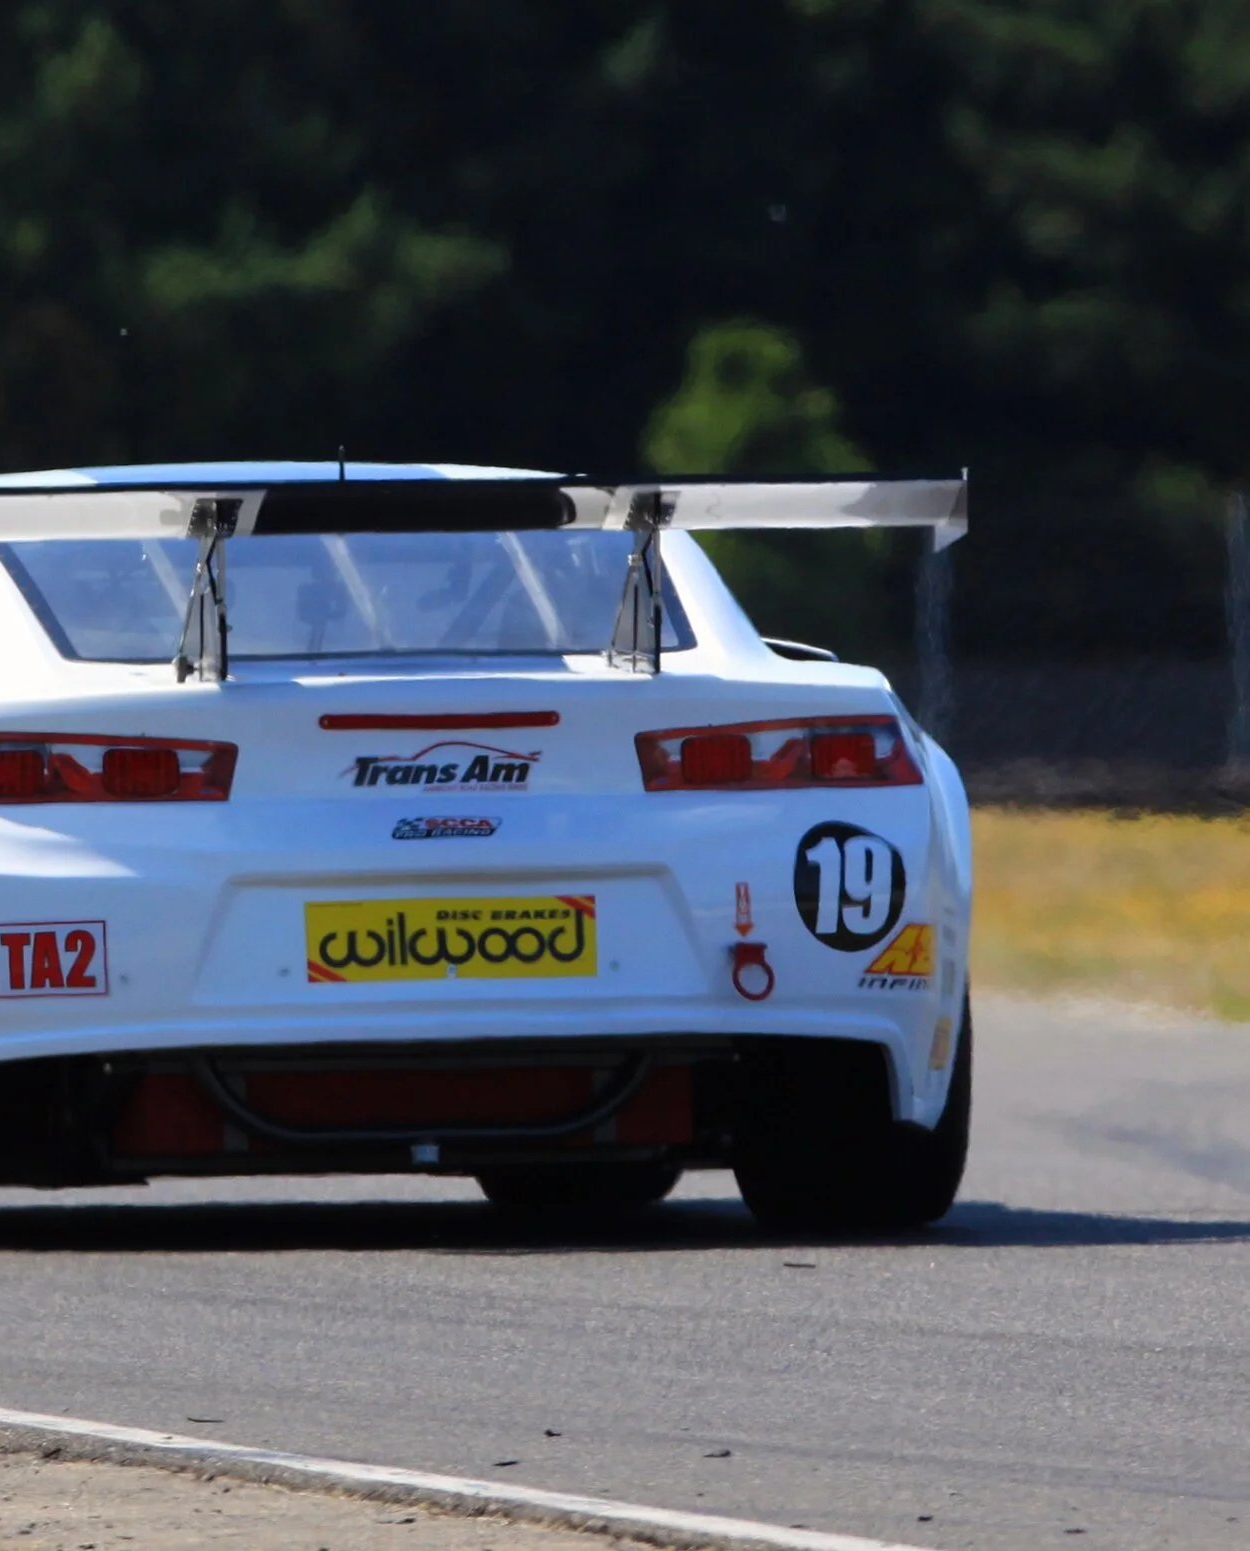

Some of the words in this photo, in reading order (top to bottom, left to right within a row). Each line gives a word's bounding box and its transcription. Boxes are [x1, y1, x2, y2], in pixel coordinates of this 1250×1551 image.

[352, 756, 459, 787] Trans
[460, 754, 531, 784] Am
[436, 910, 482, 921] DISC
[490, 909, 571, 920] BRAKES
[805, 835, 893, 935] 19
[0, 929, 97, 990] TA2
[319, 908, 584, 968] wilwood
